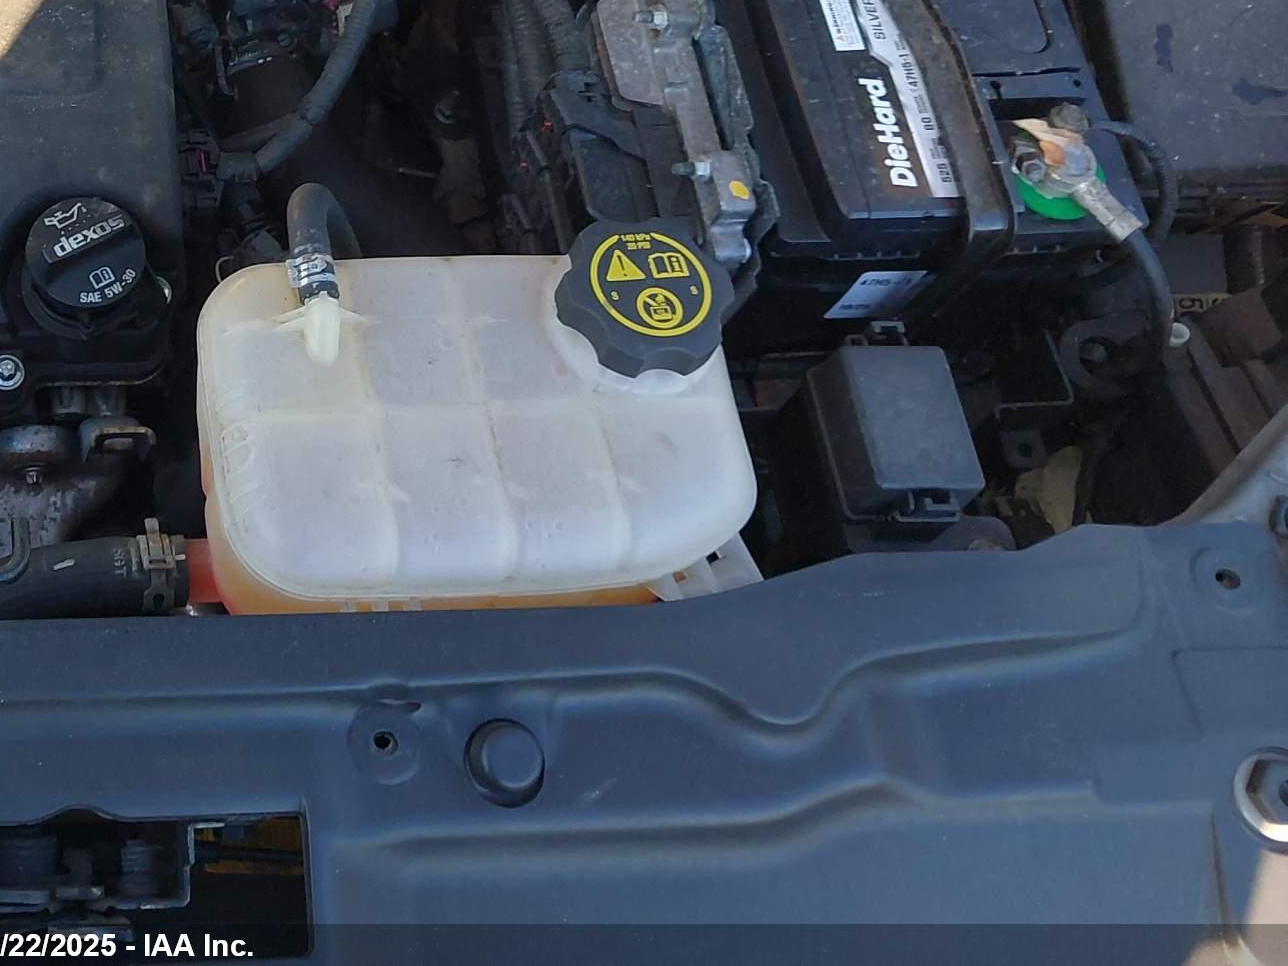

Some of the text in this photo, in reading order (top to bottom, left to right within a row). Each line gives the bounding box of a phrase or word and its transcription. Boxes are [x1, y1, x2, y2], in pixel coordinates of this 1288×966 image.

[857, 77, 919, 187] DieHard
[53, 213, 125, 257] dexos
[79, 268, 137, 304] SAE 5W-30
